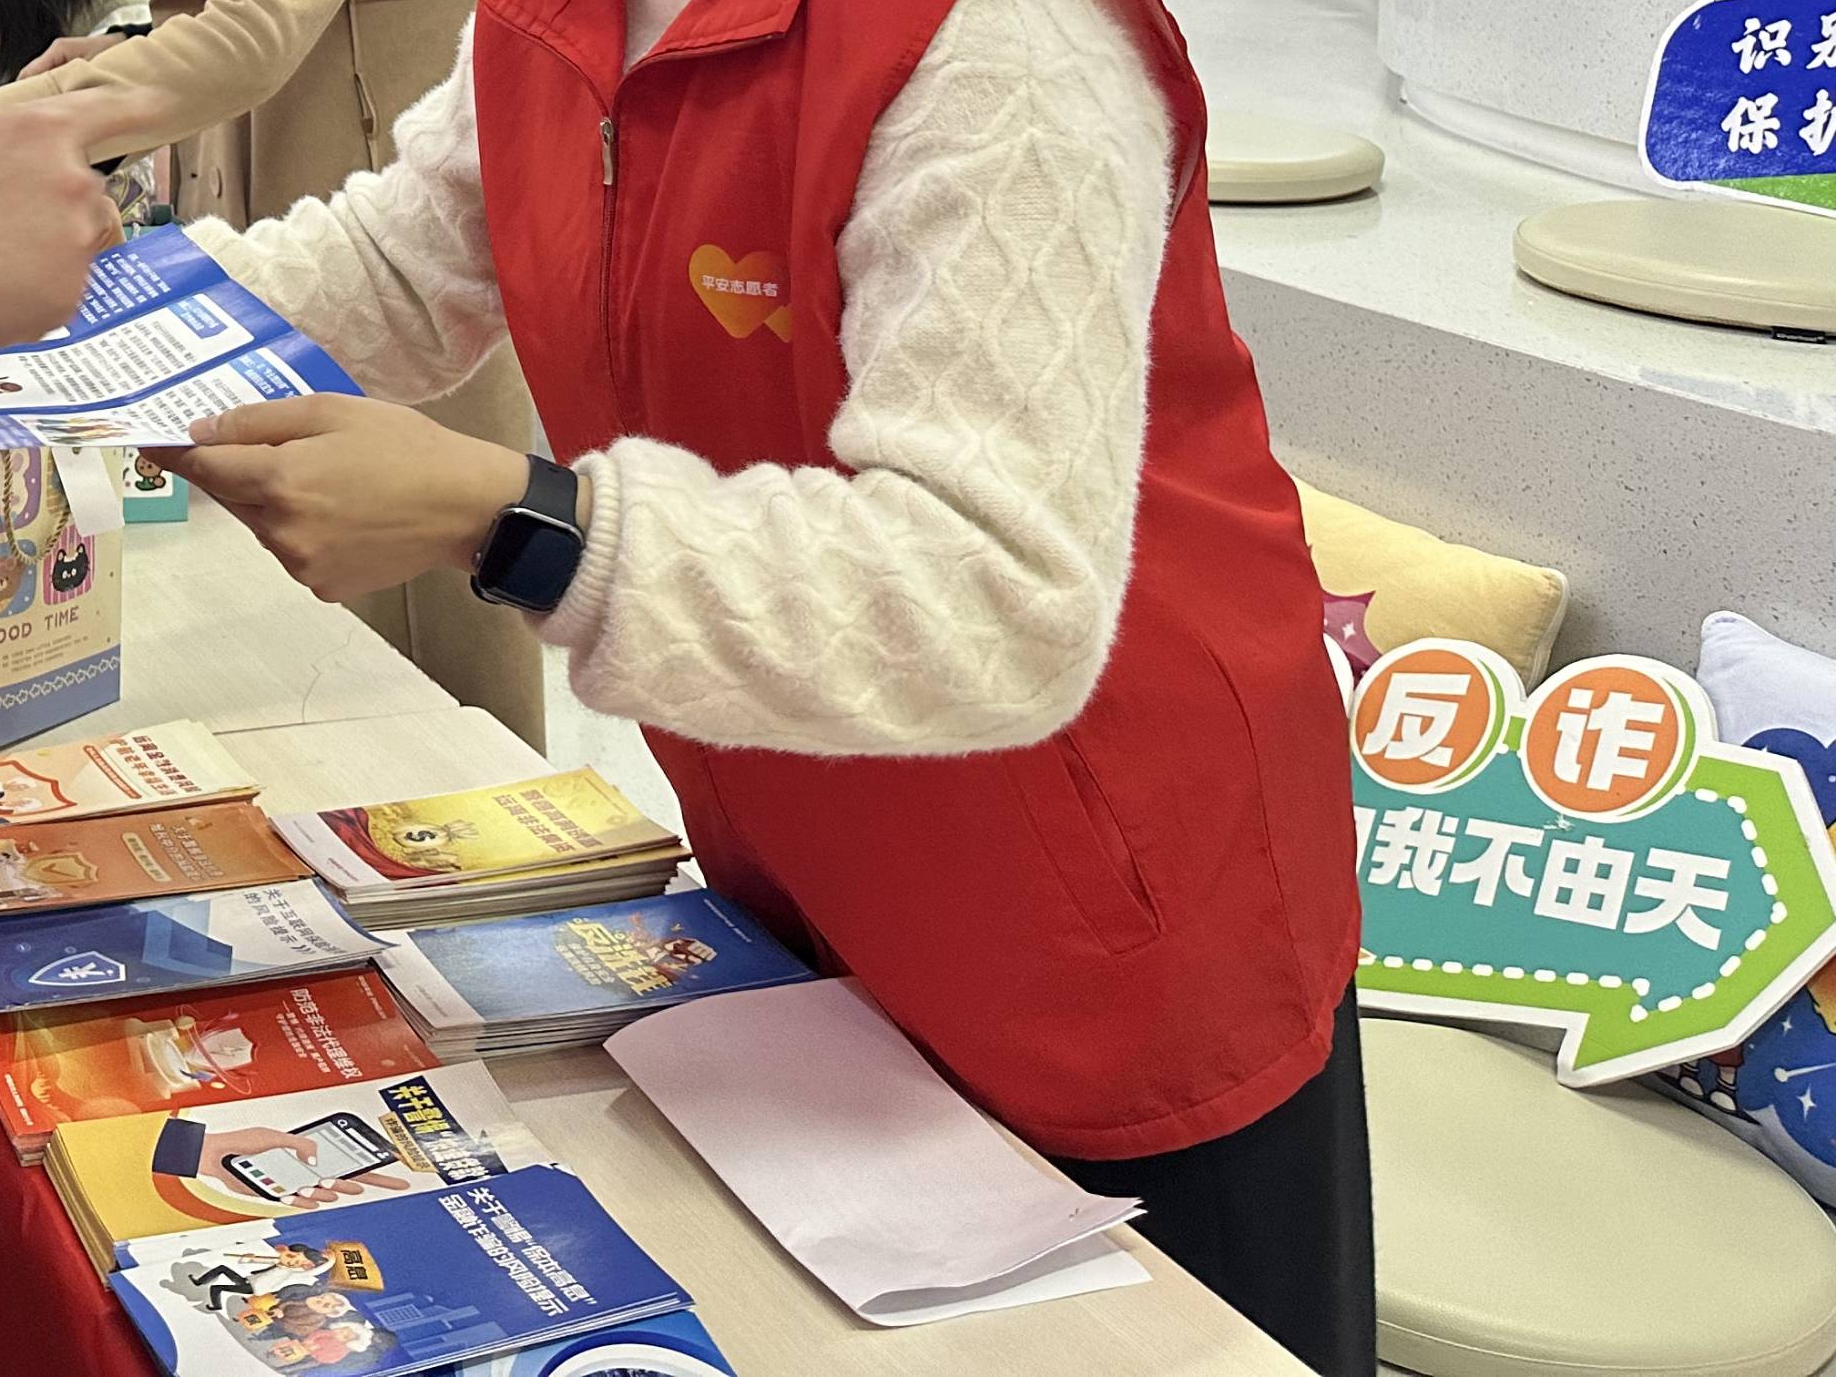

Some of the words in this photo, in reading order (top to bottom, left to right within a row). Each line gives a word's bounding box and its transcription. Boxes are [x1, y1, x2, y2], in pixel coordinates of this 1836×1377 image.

[701, 274, 780, 299] 平安志愿者
[44, 606, 80, 632] TIME
[1362, 672, 1665, 792] 反诈
[566, 920, 673, 997] 反洗钱
[290, 987, 364, 1080] 防范非法代理维权
[438, 1193, 569, 1317] 金融诈骗的风险提示
